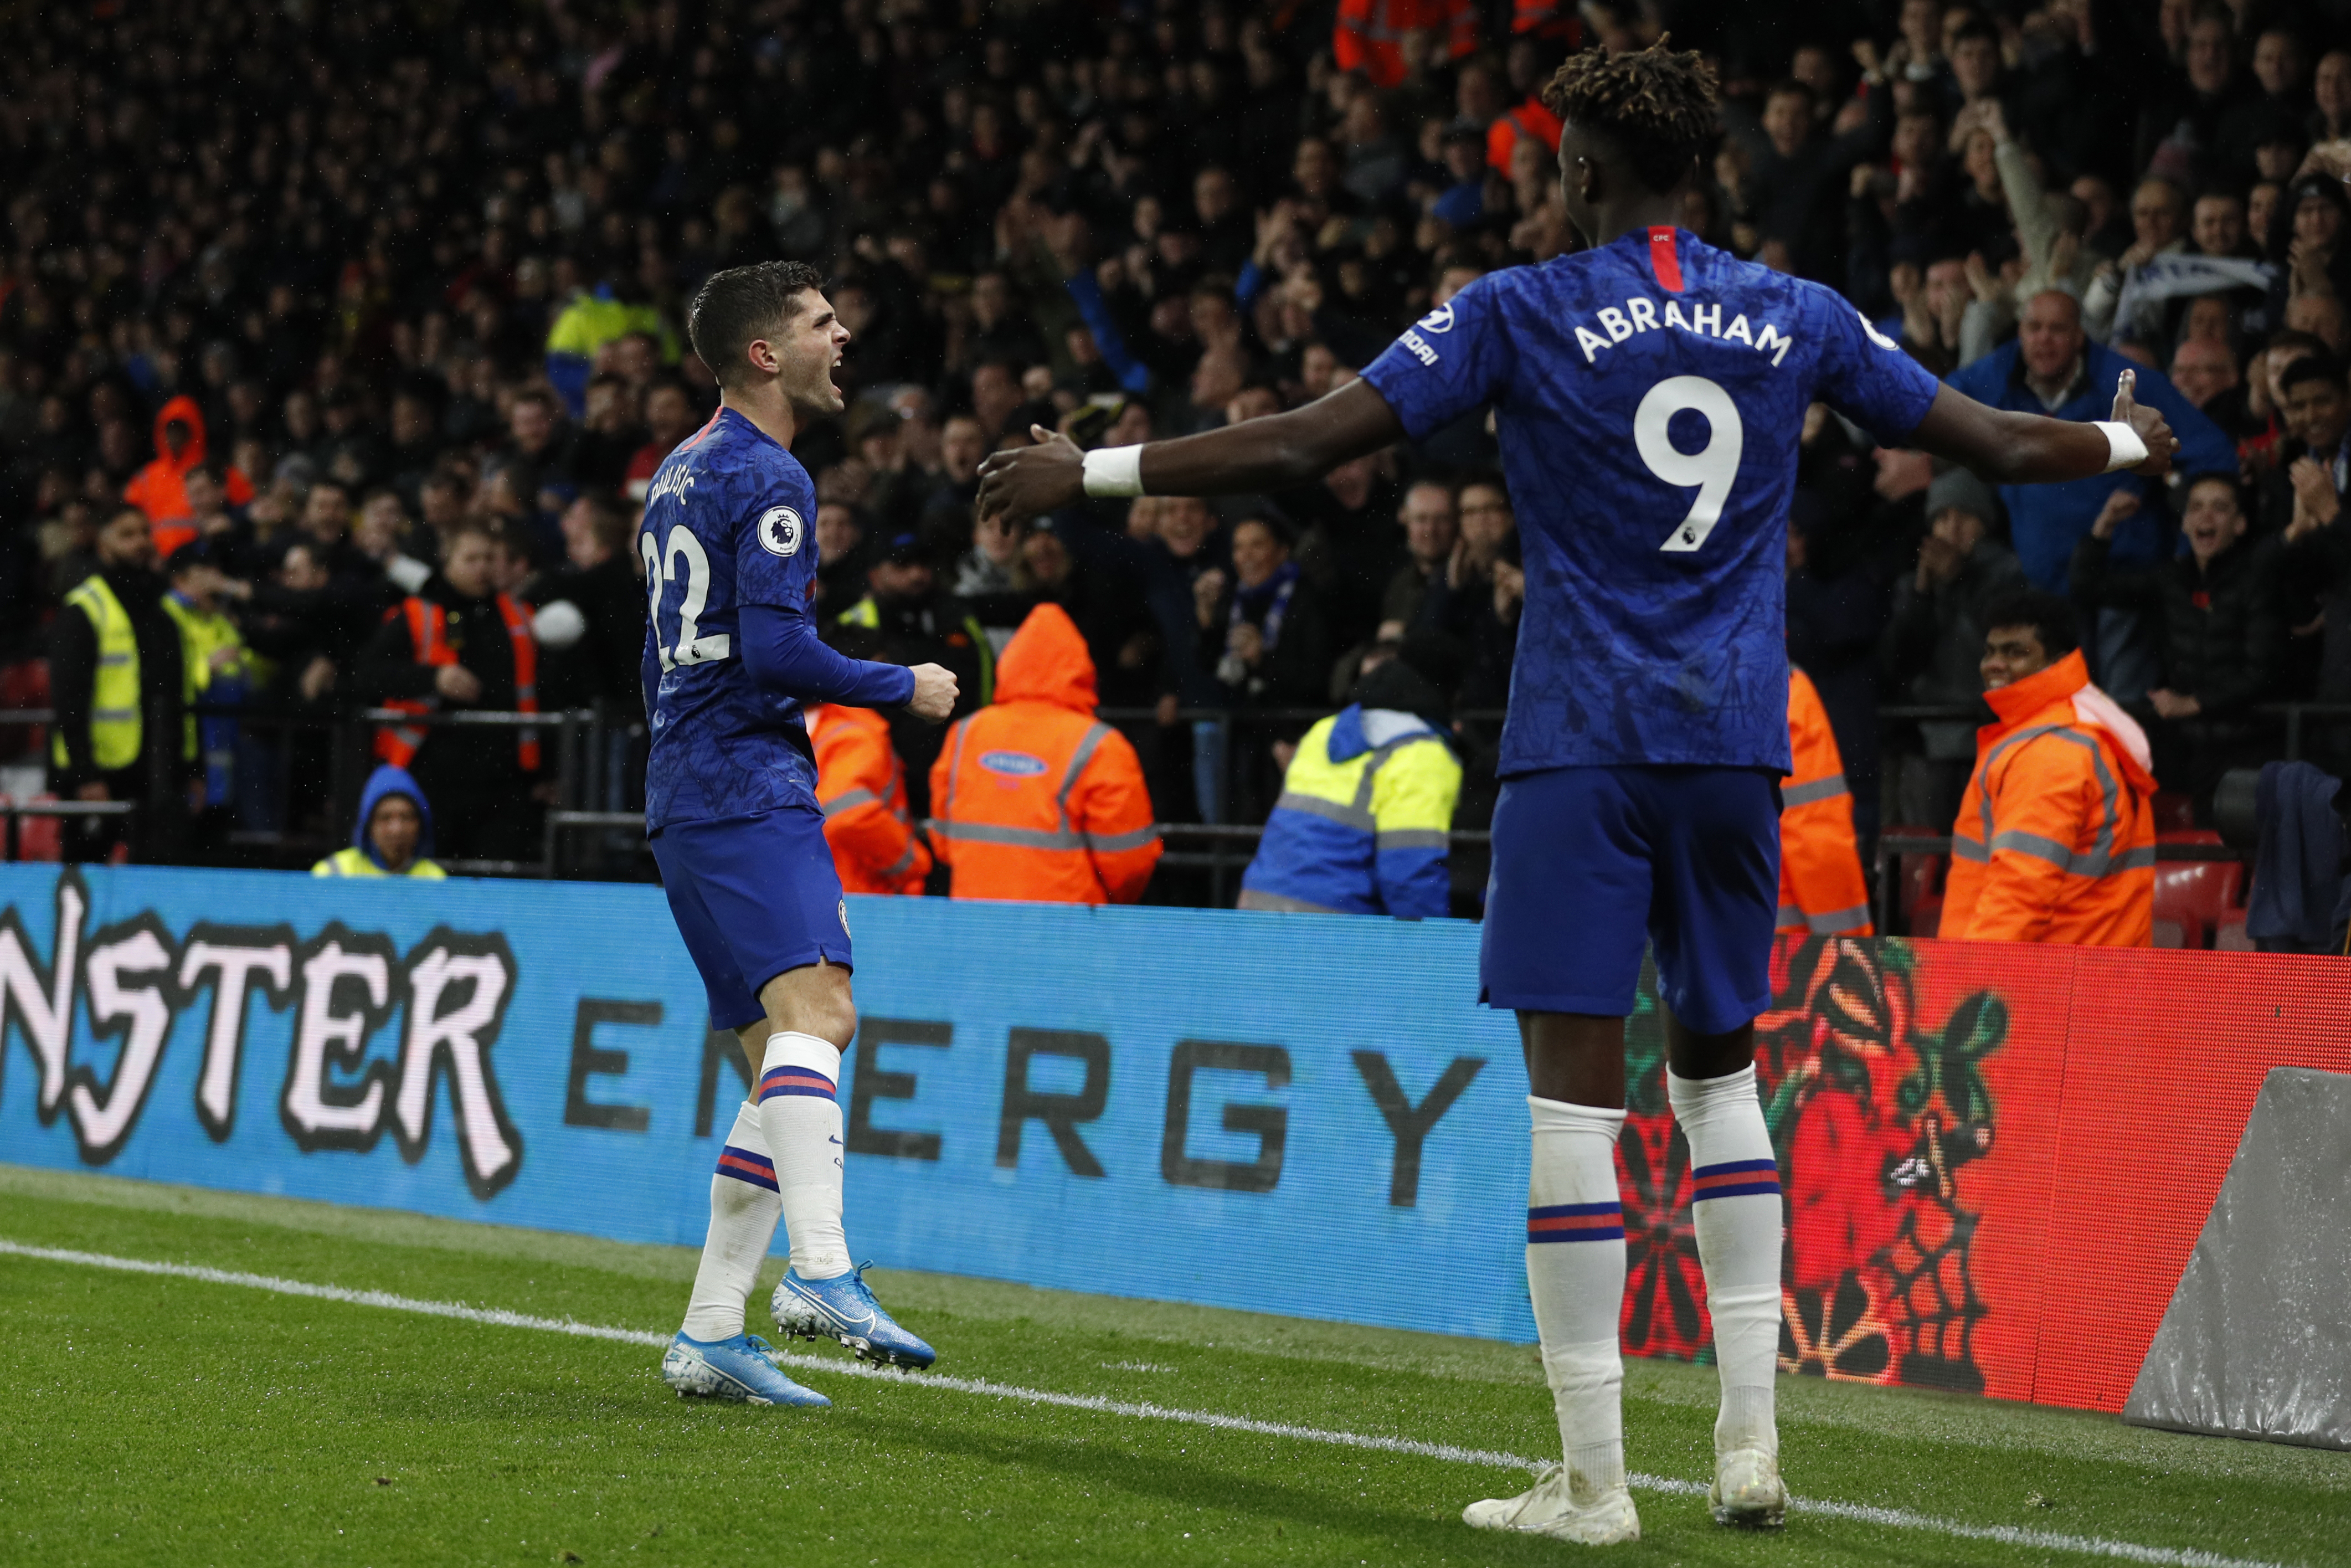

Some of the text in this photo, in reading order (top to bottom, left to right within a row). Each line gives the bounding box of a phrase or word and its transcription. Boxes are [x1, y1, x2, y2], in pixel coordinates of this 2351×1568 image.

[1574, 297, 1793, 367] ABRAHAM
[650, 464, 695, 506] PULISIC
[1633, 375, 1743, 552] 9
[641, 524, 730, 674] 22
